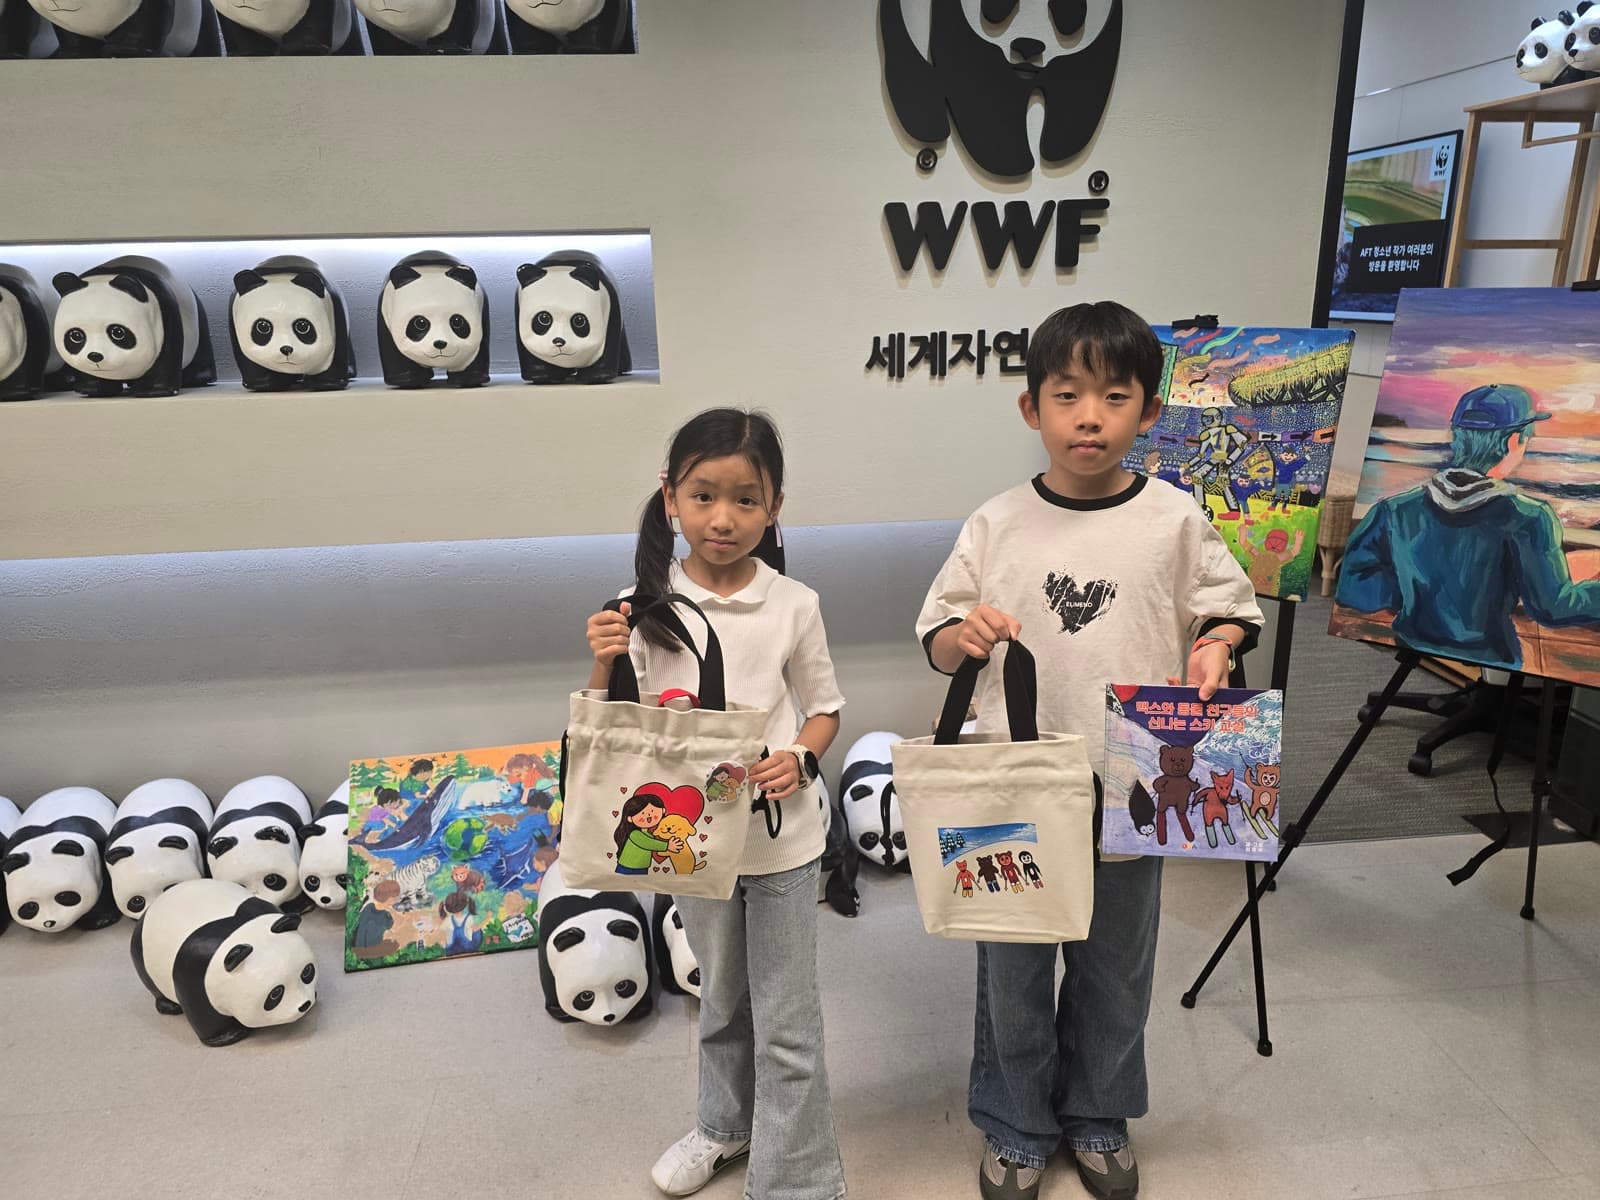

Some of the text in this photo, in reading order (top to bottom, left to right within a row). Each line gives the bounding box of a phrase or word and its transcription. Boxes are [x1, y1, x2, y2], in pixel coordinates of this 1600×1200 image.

[884, 198, 1110, 271] WWF
[1360, 243, 1434, 257] AFT 청소년 작가 여러분의
[1388, 259, 1420, 272] 환영합니다
[1206, 703, 1259, 718] 친구들의
[1148, 716, 1246, 733] 신나는 스키 교실
